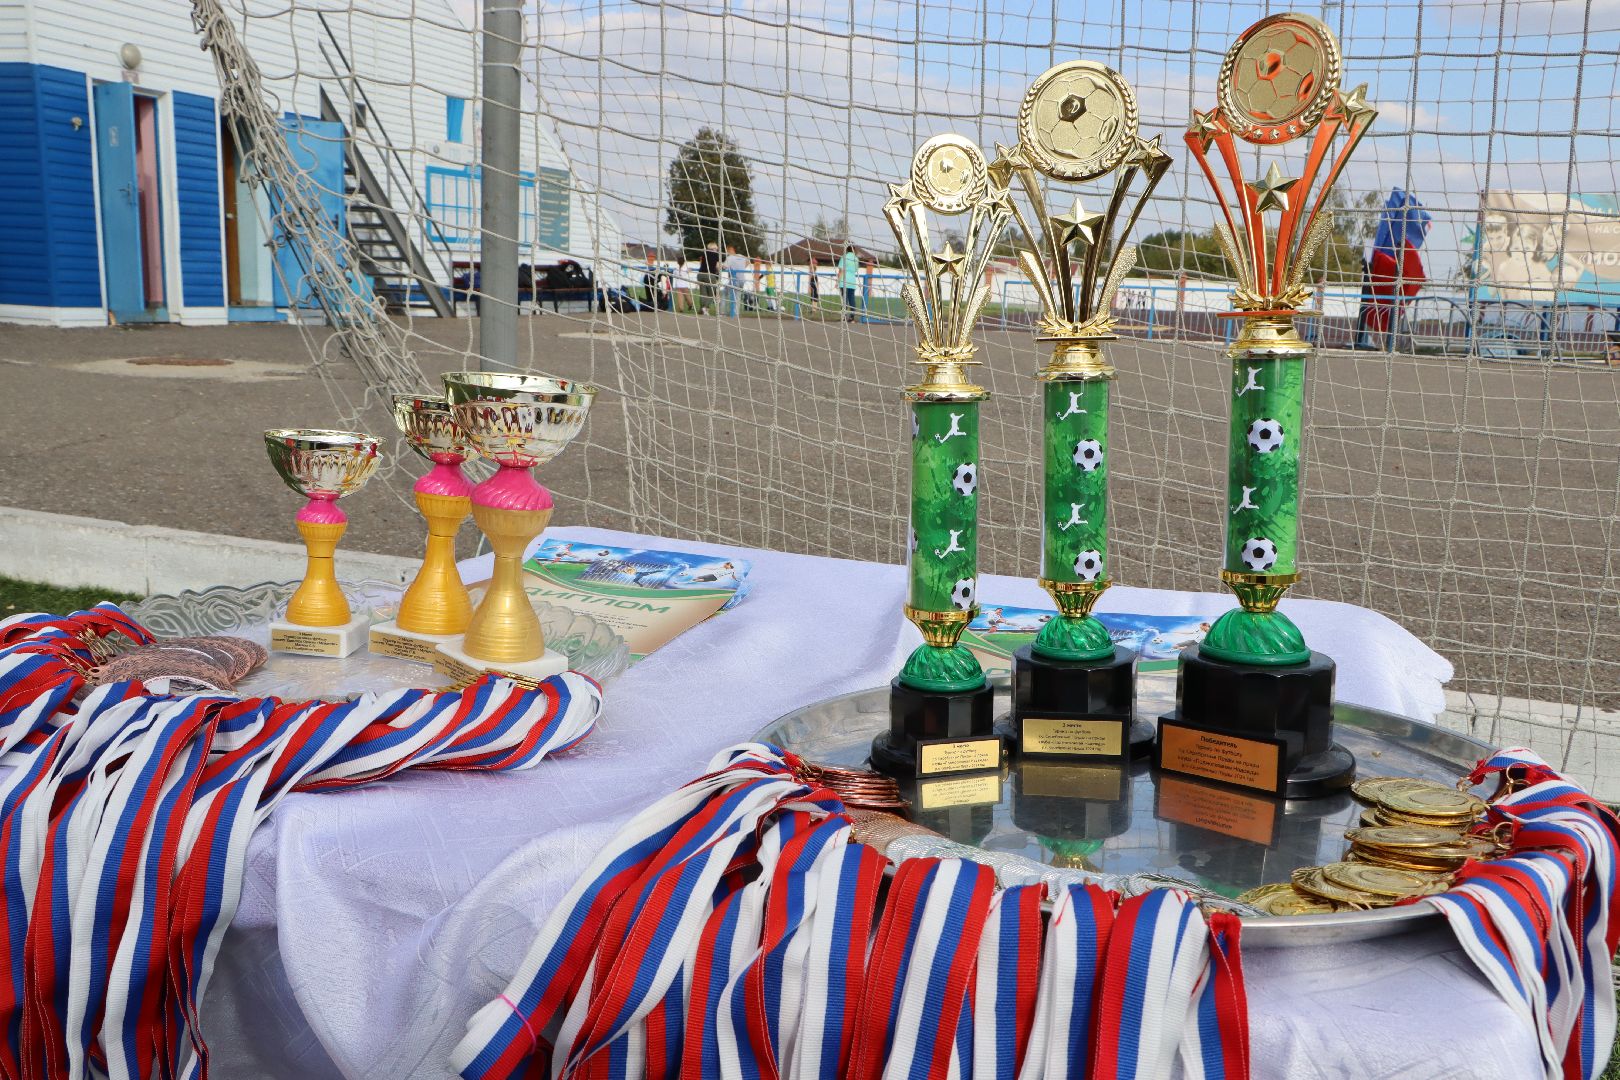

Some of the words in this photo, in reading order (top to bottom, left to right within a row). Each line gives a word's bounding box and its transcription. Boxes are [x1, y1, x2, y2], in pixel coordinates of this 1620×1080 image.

[1577, 252, 1620, 266] «МО
[524, 586, 672, 614] ДИПЛОМ
[1200, 735, 1238, 749] Победитель
